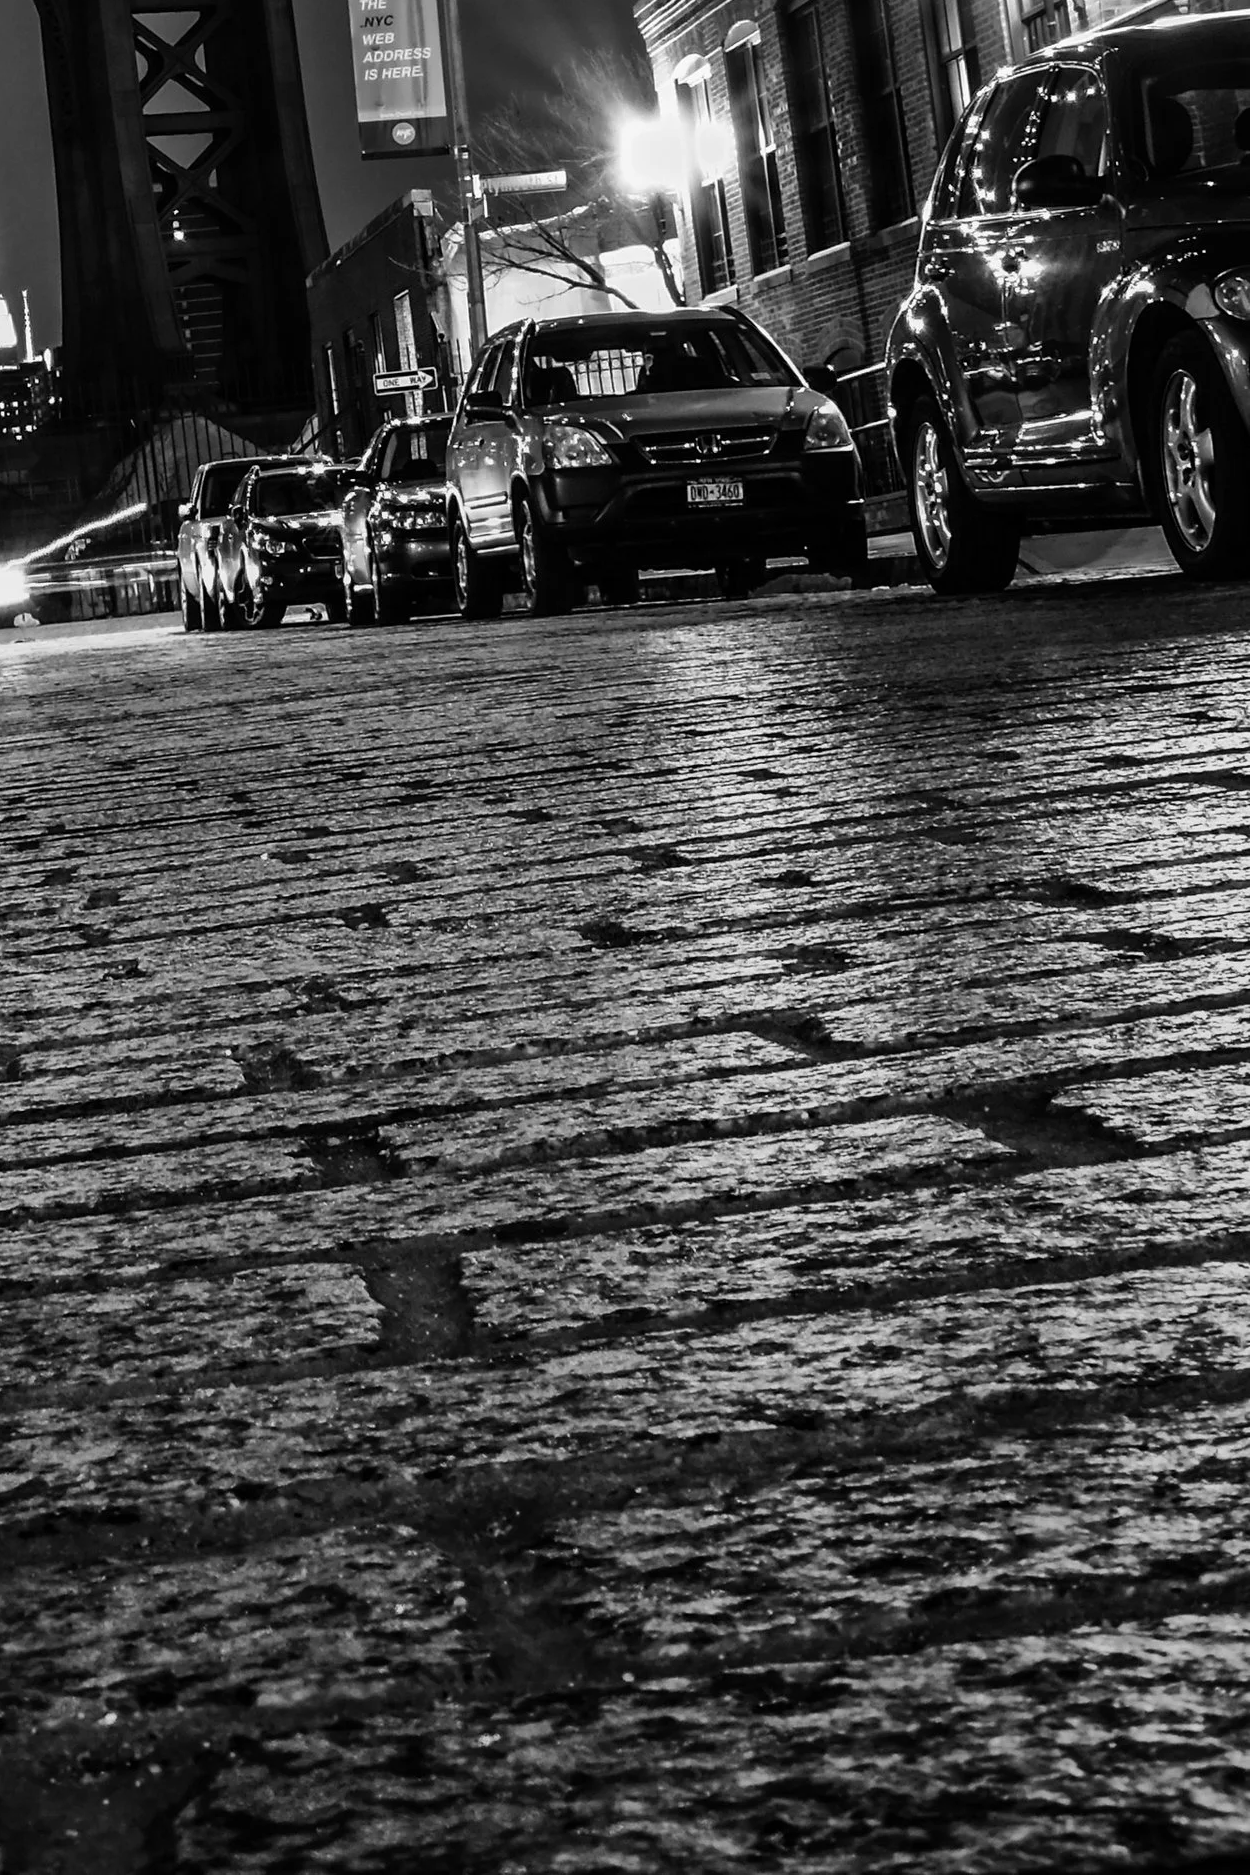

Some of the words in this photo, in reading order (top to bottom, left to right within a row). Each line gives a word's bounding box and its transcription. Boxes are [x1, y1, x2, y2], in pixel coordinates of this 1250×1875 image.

[359, 15, 394, 28] .NYC
[362, 32, 395, 46] WEB
[362, 47, 431, 63] ADDRESS
[364, 69, 378, 81] IS
[382, 65, 424, 79] HERE.
[383, 378, 400, 388] ONE
[409, 375, 427, 385] WAY
